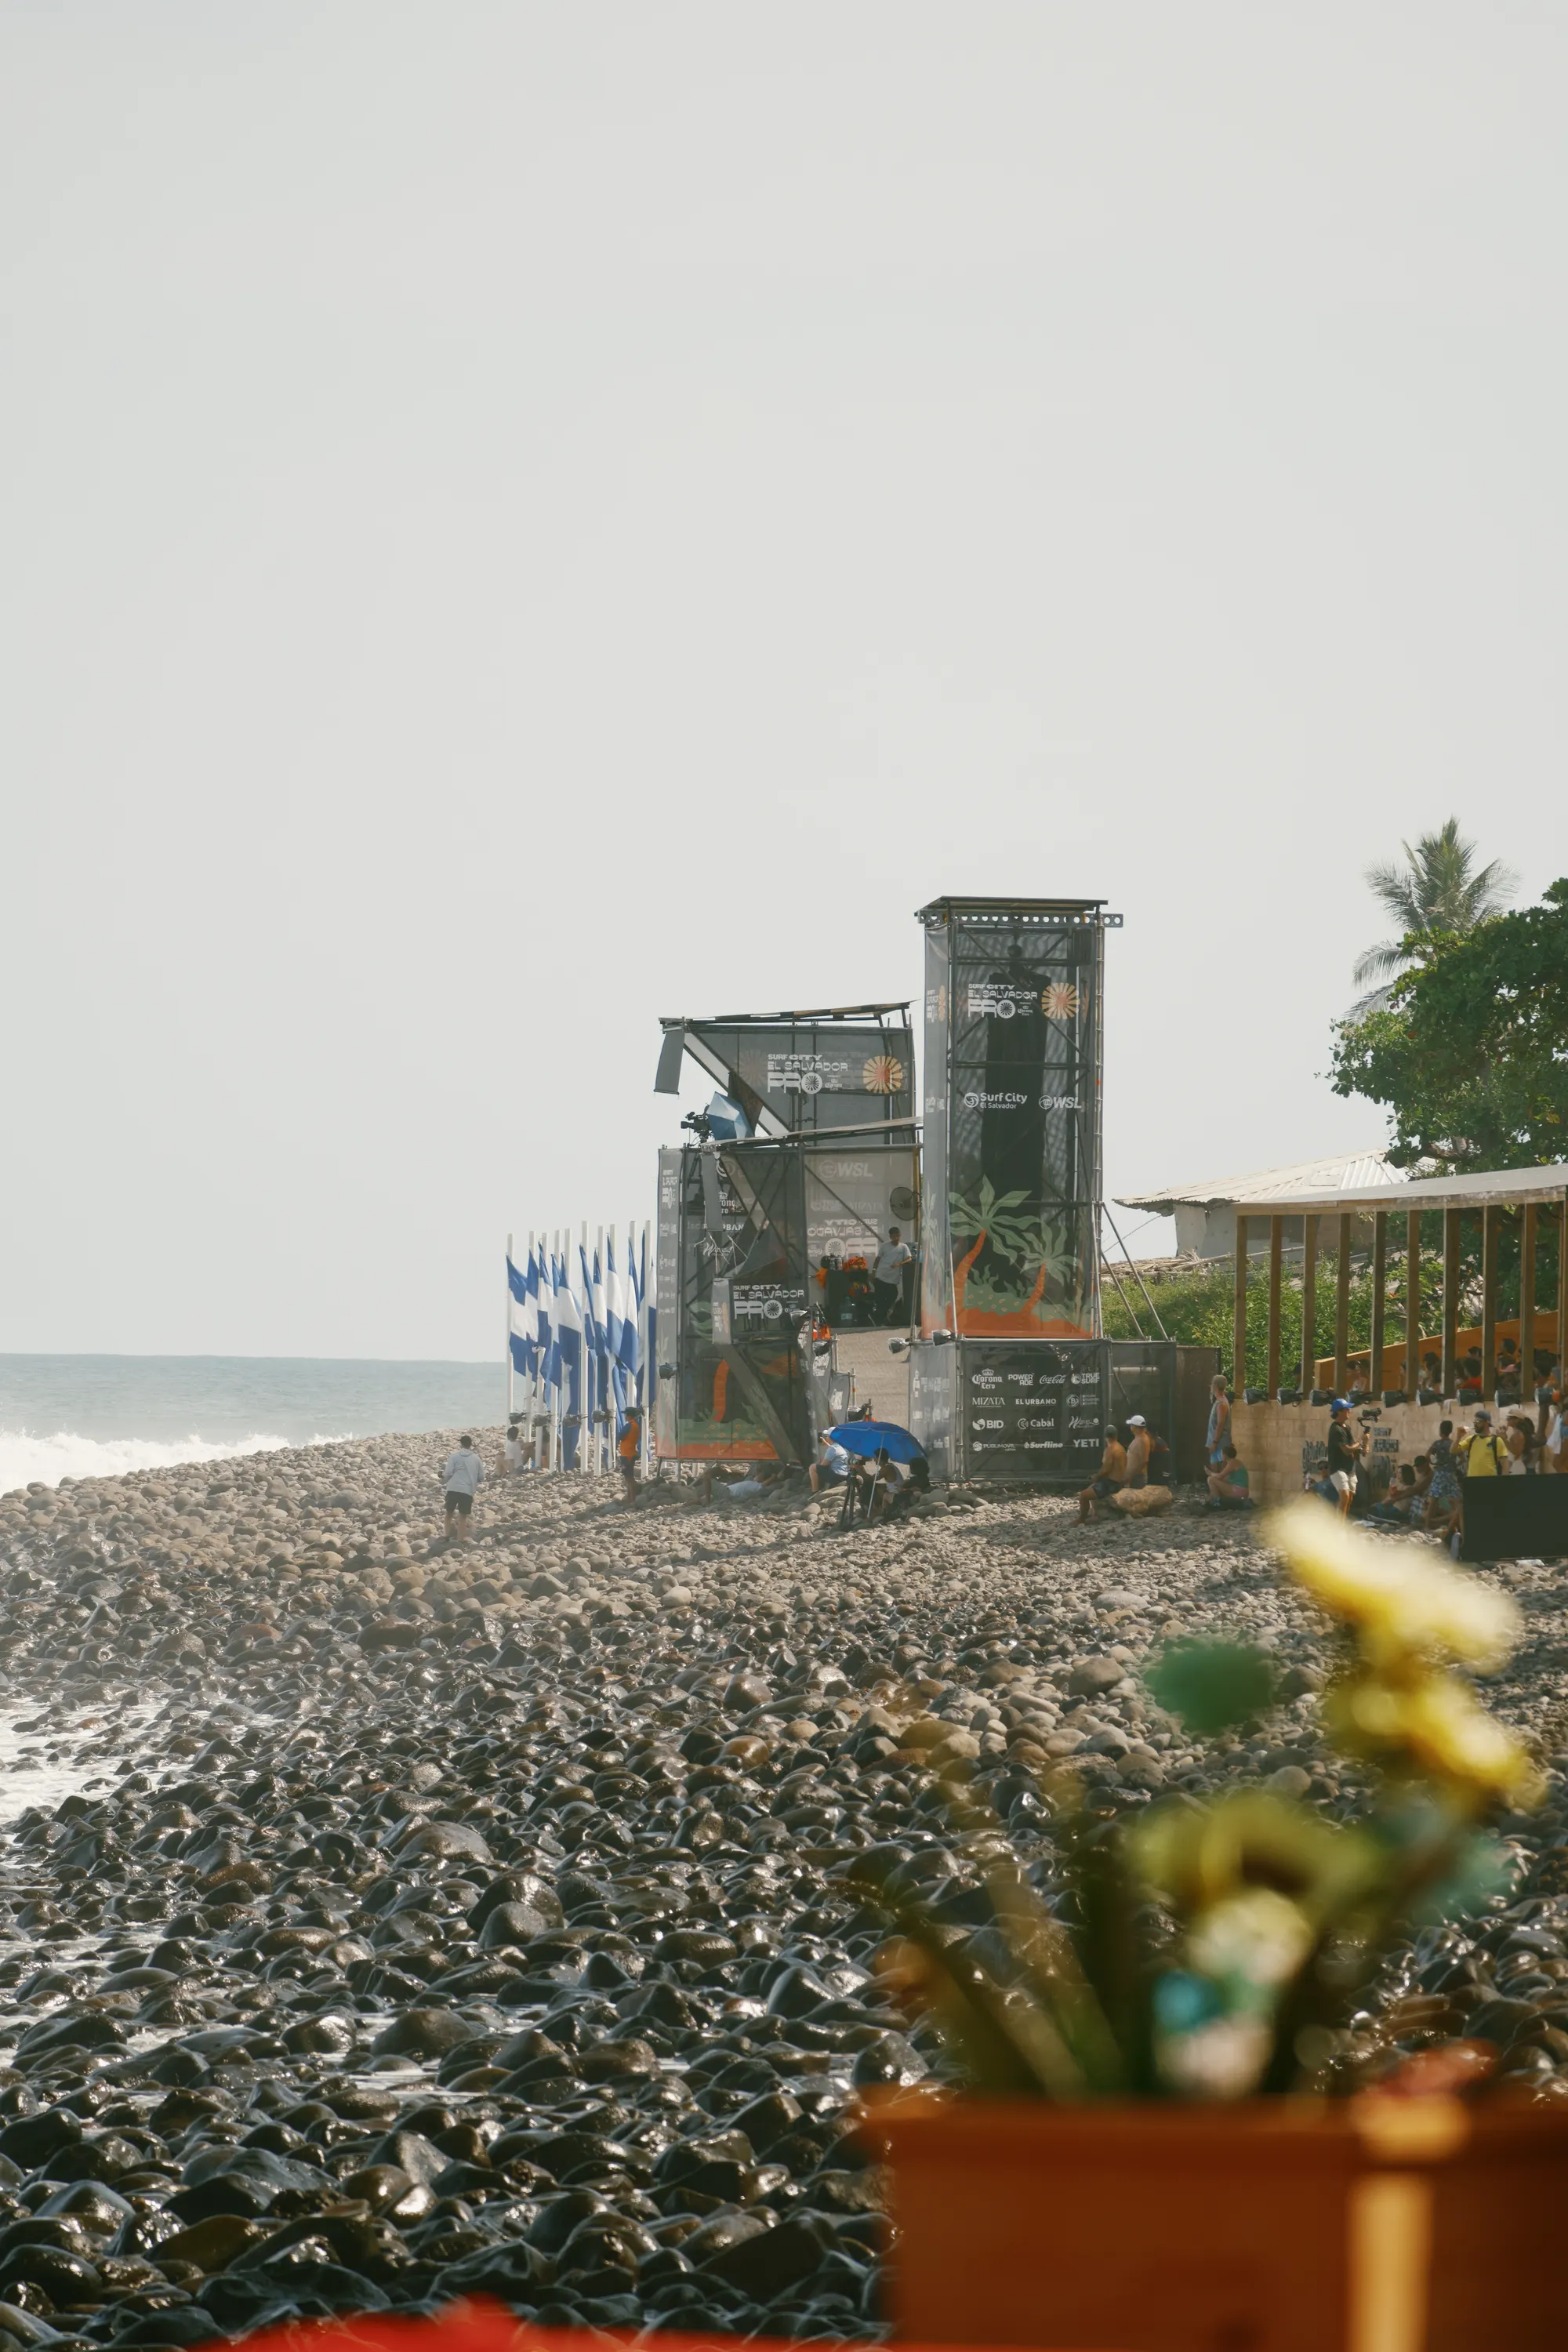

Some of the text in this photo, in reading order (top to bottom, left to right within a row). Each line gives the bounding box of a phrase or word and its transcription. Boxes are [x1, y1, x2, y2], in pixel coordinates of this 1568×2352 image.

[982, 990, 1037, 999] SALVADOR
[967, 999, 1016, 1019] PRO
[768, 1062, 848, 1071] EL SALVADOR
[768, 1072, 823, 1094] PRO
[980, 1093, 1028, 1104] Surf City
[1054, 1097, 1082, 1109] WSL
[837, 1163, 873, 1177] WSL
[749, 1290, 804, 1298] SALVADOR
[734, 1300, 782, 1319] PRO
[972, 1374, 1003, 1385] Corona
[986, 1421, 1004, 1429] BID
[1030, 1418, 1054, 1428] Cabal
[1073, 1439, 1099, 1448] YETI
